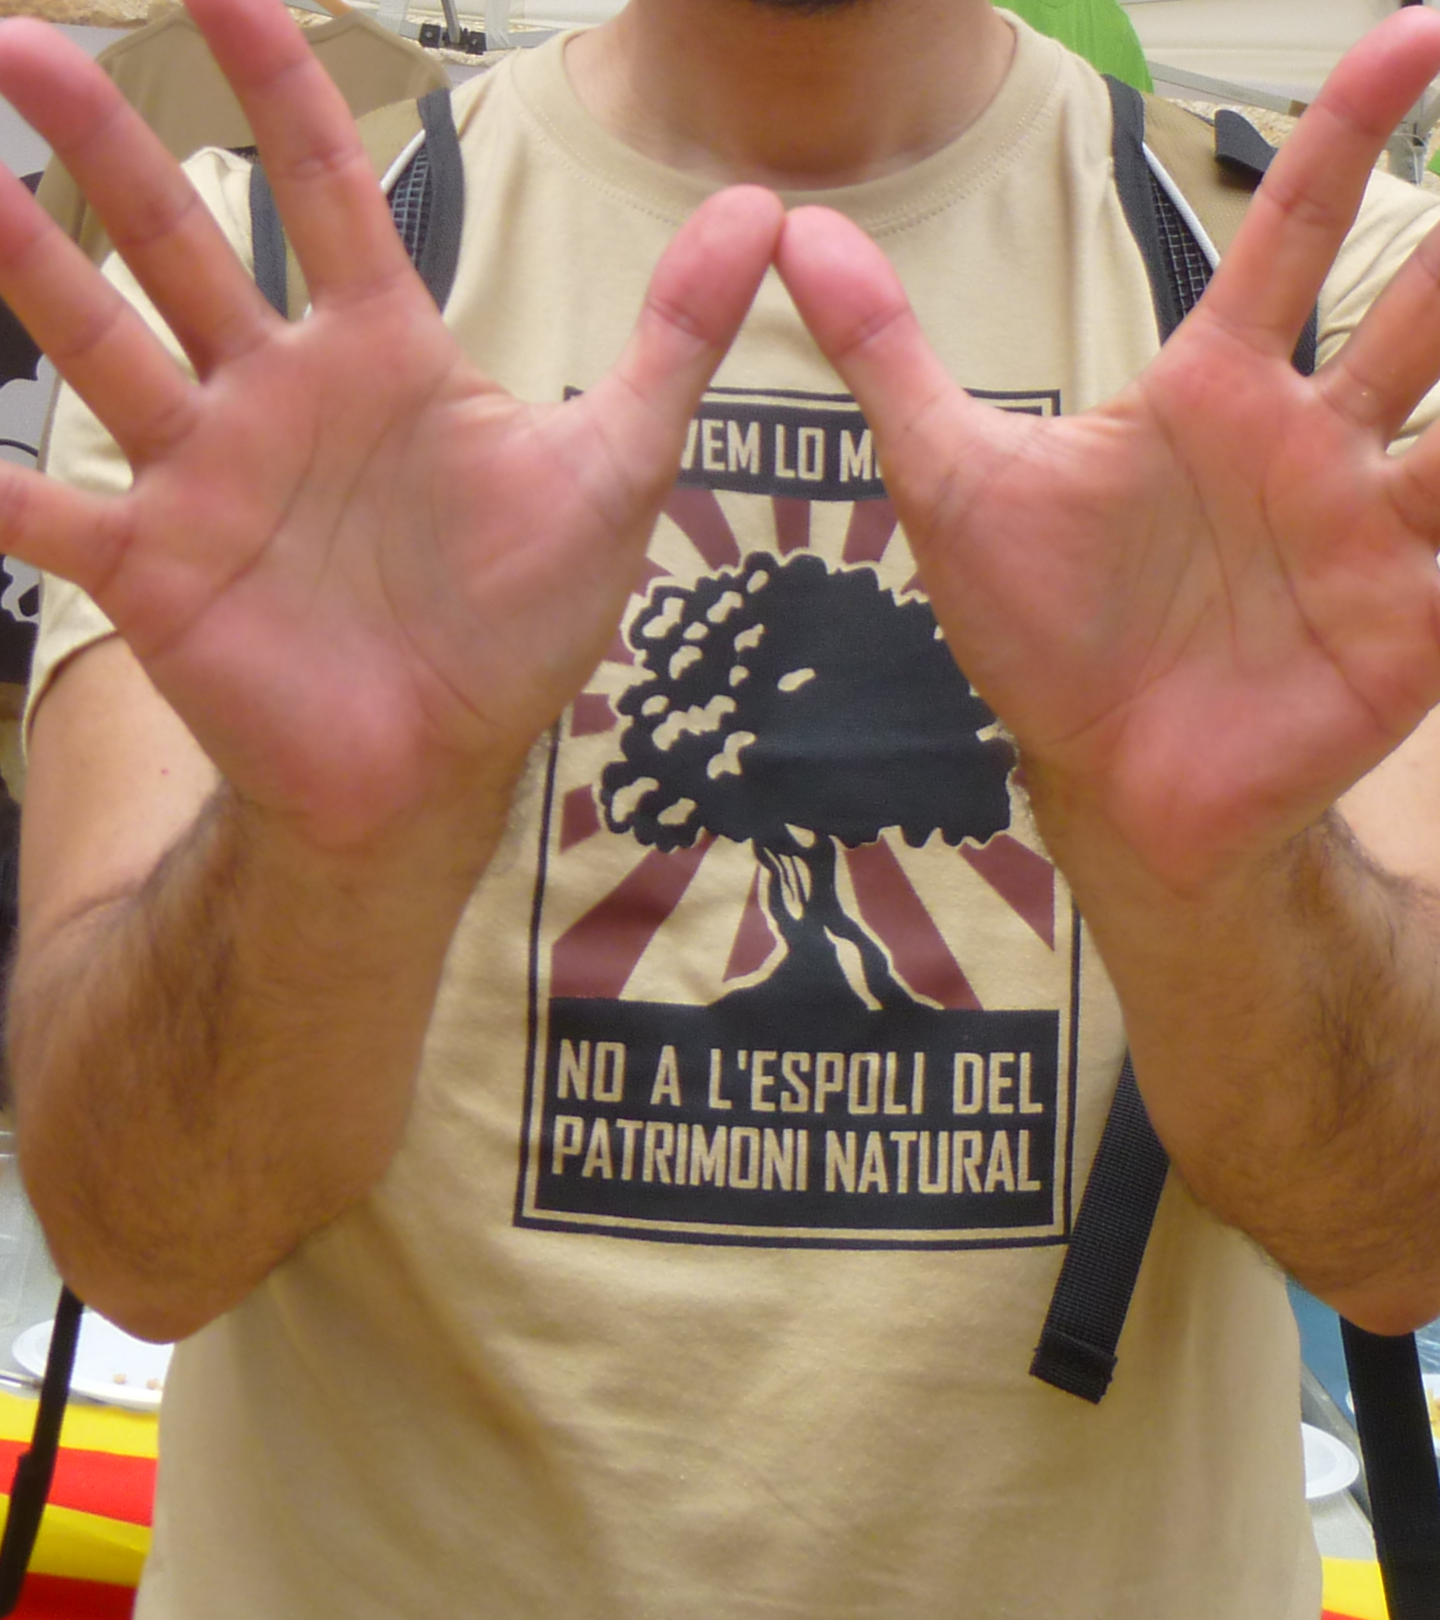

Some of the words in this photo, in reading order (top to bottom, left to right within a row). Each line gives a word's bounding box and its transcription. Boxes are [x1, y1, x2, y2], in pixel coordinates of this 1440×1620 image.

[774, 423, 825, 481] LO
[557, 1038, 627, 1103] NO
[650, 1045, 682, 1107] A
[709, 1048, 926, 1115] L'ESPOLI
[953, 1051, 1044, 1115] DEL
[551, 1114, 809, 1191] PATRIMONI
[824, 1129, 1041, 1194] NATURAL
